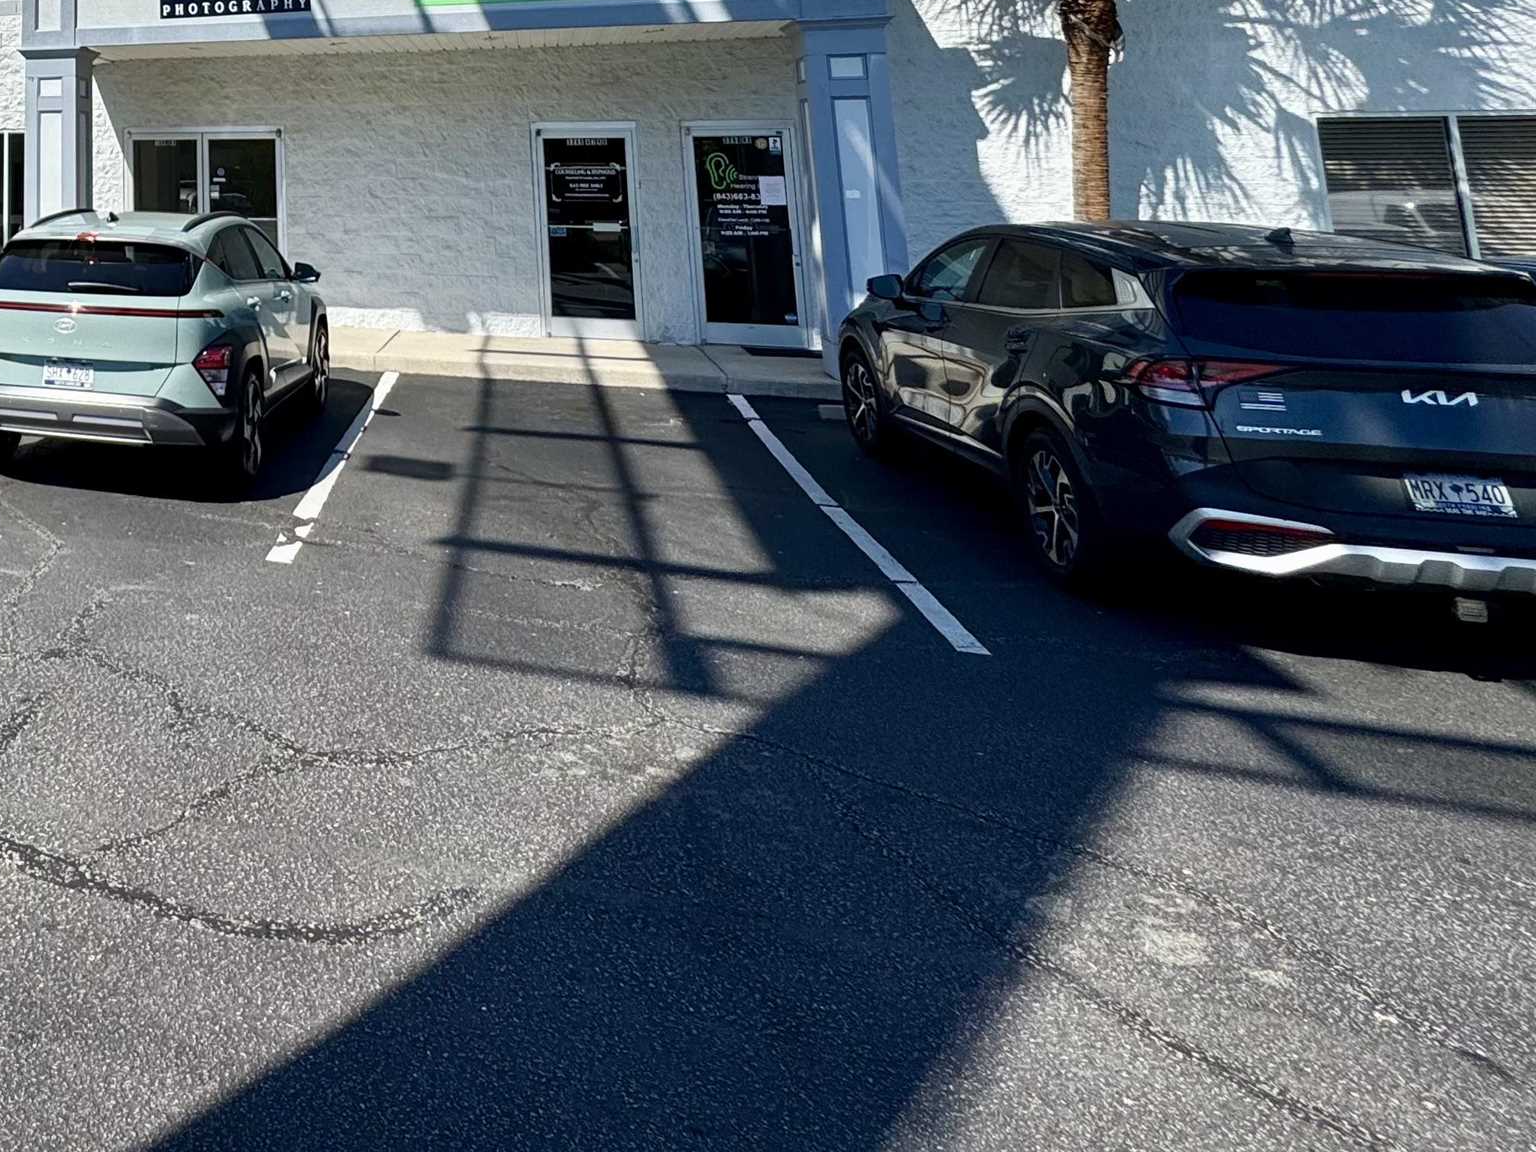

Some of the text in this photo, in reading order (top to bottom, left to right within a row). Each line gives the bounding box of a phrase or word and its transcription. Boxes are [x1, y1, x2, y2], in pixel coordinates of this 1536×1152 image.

[1401, 389, 1479, 407] KIA
[1236, 425, 1322, 436] SPORTAGE
[1410, 479, 1505, 505] MRX 540
